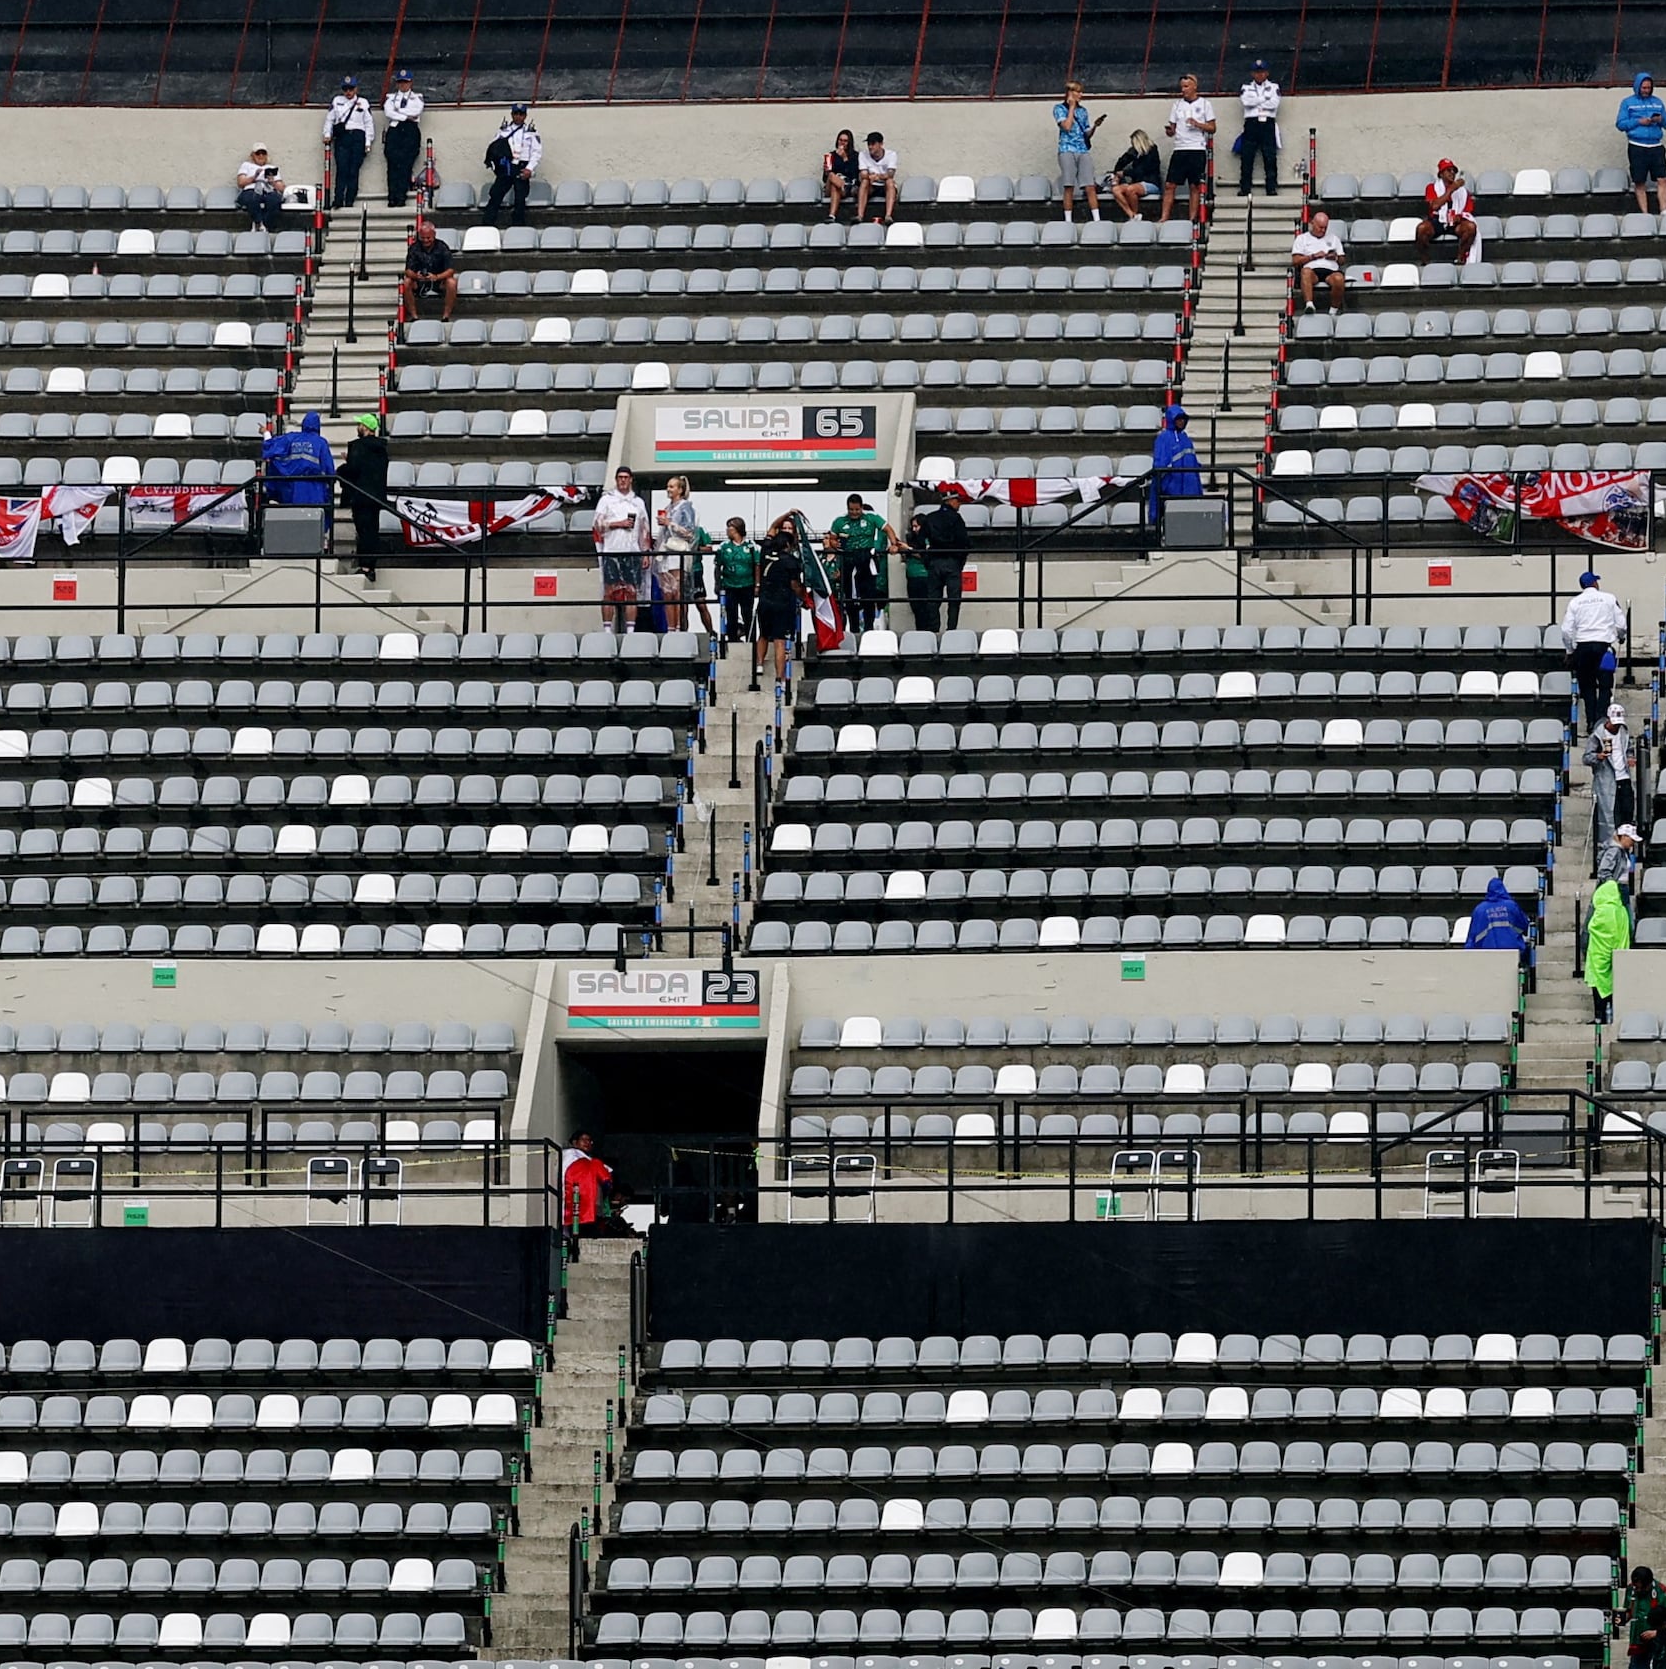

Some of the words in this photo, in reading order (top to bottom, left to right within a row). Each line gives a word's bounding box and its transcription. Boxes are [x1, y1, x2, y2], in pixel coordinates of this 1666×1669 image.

[682, 409, 790, 430] SALIDA
[815, 408, 865, 438] 65
[761, 430, 790, 438] EXIT
[712, 452, 737, 461] SALIDA
[576, 973, 689, 994] SALIDA
[705, 973, 757, 1003] 23
[659, 995, 689, 1004] EXIT
[607, 1018, 634, 1027] SALIDA
